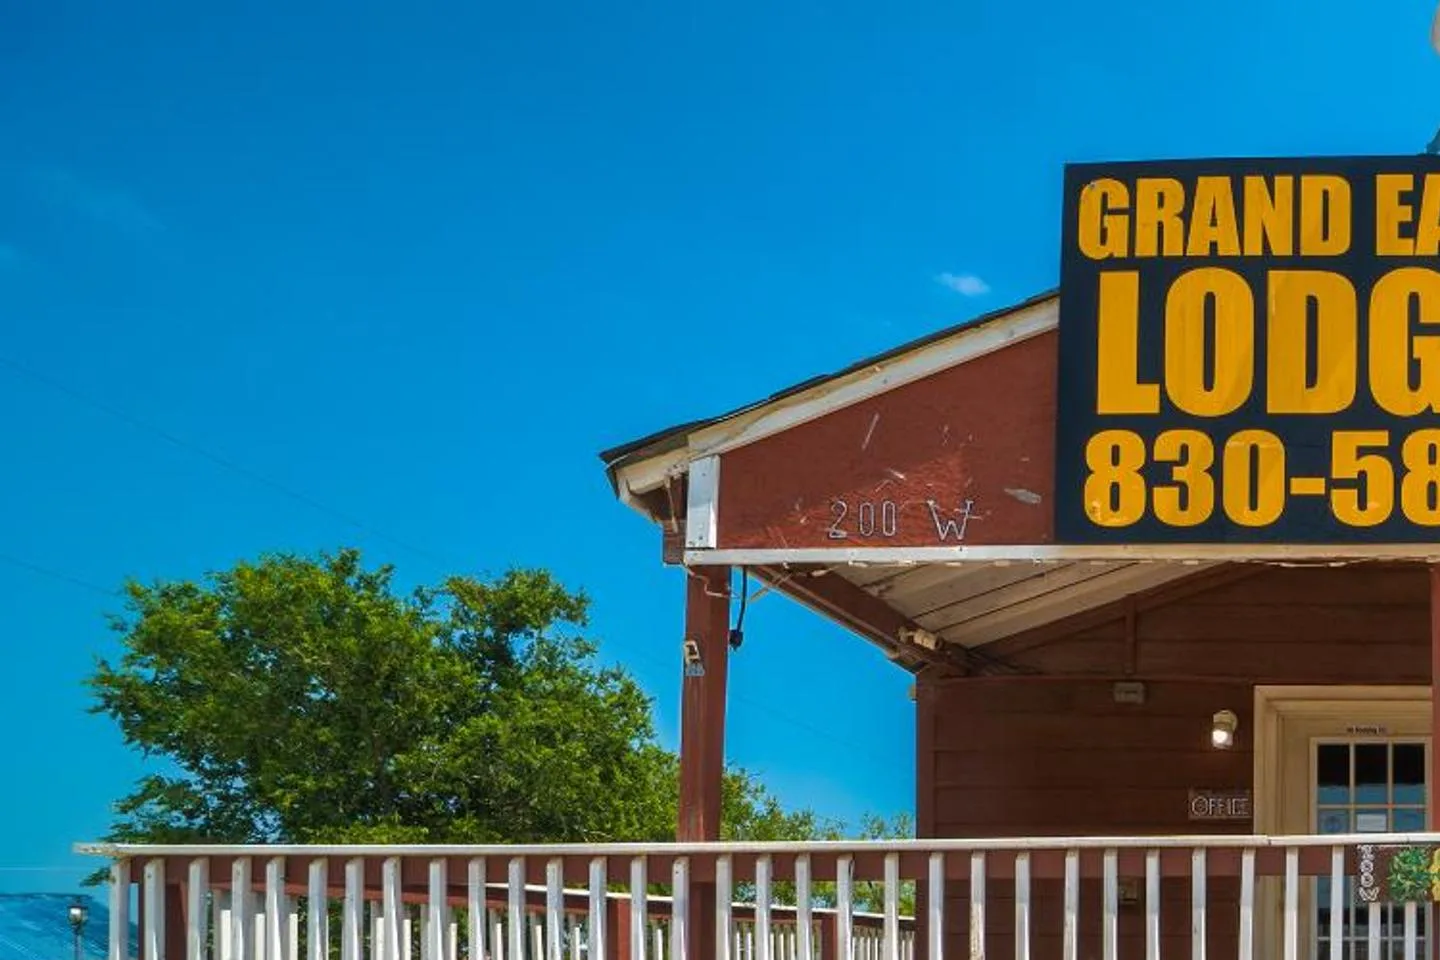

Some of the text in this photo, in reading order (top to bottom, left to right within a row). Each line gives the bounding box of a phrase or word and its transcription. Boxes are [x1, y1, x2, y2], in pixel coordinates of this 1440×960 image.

[1078, 174, 1353, 261] GRAND
[828, 499, 975, 541] 200 W
[1191, 795, 1249, 816] OFFICE
